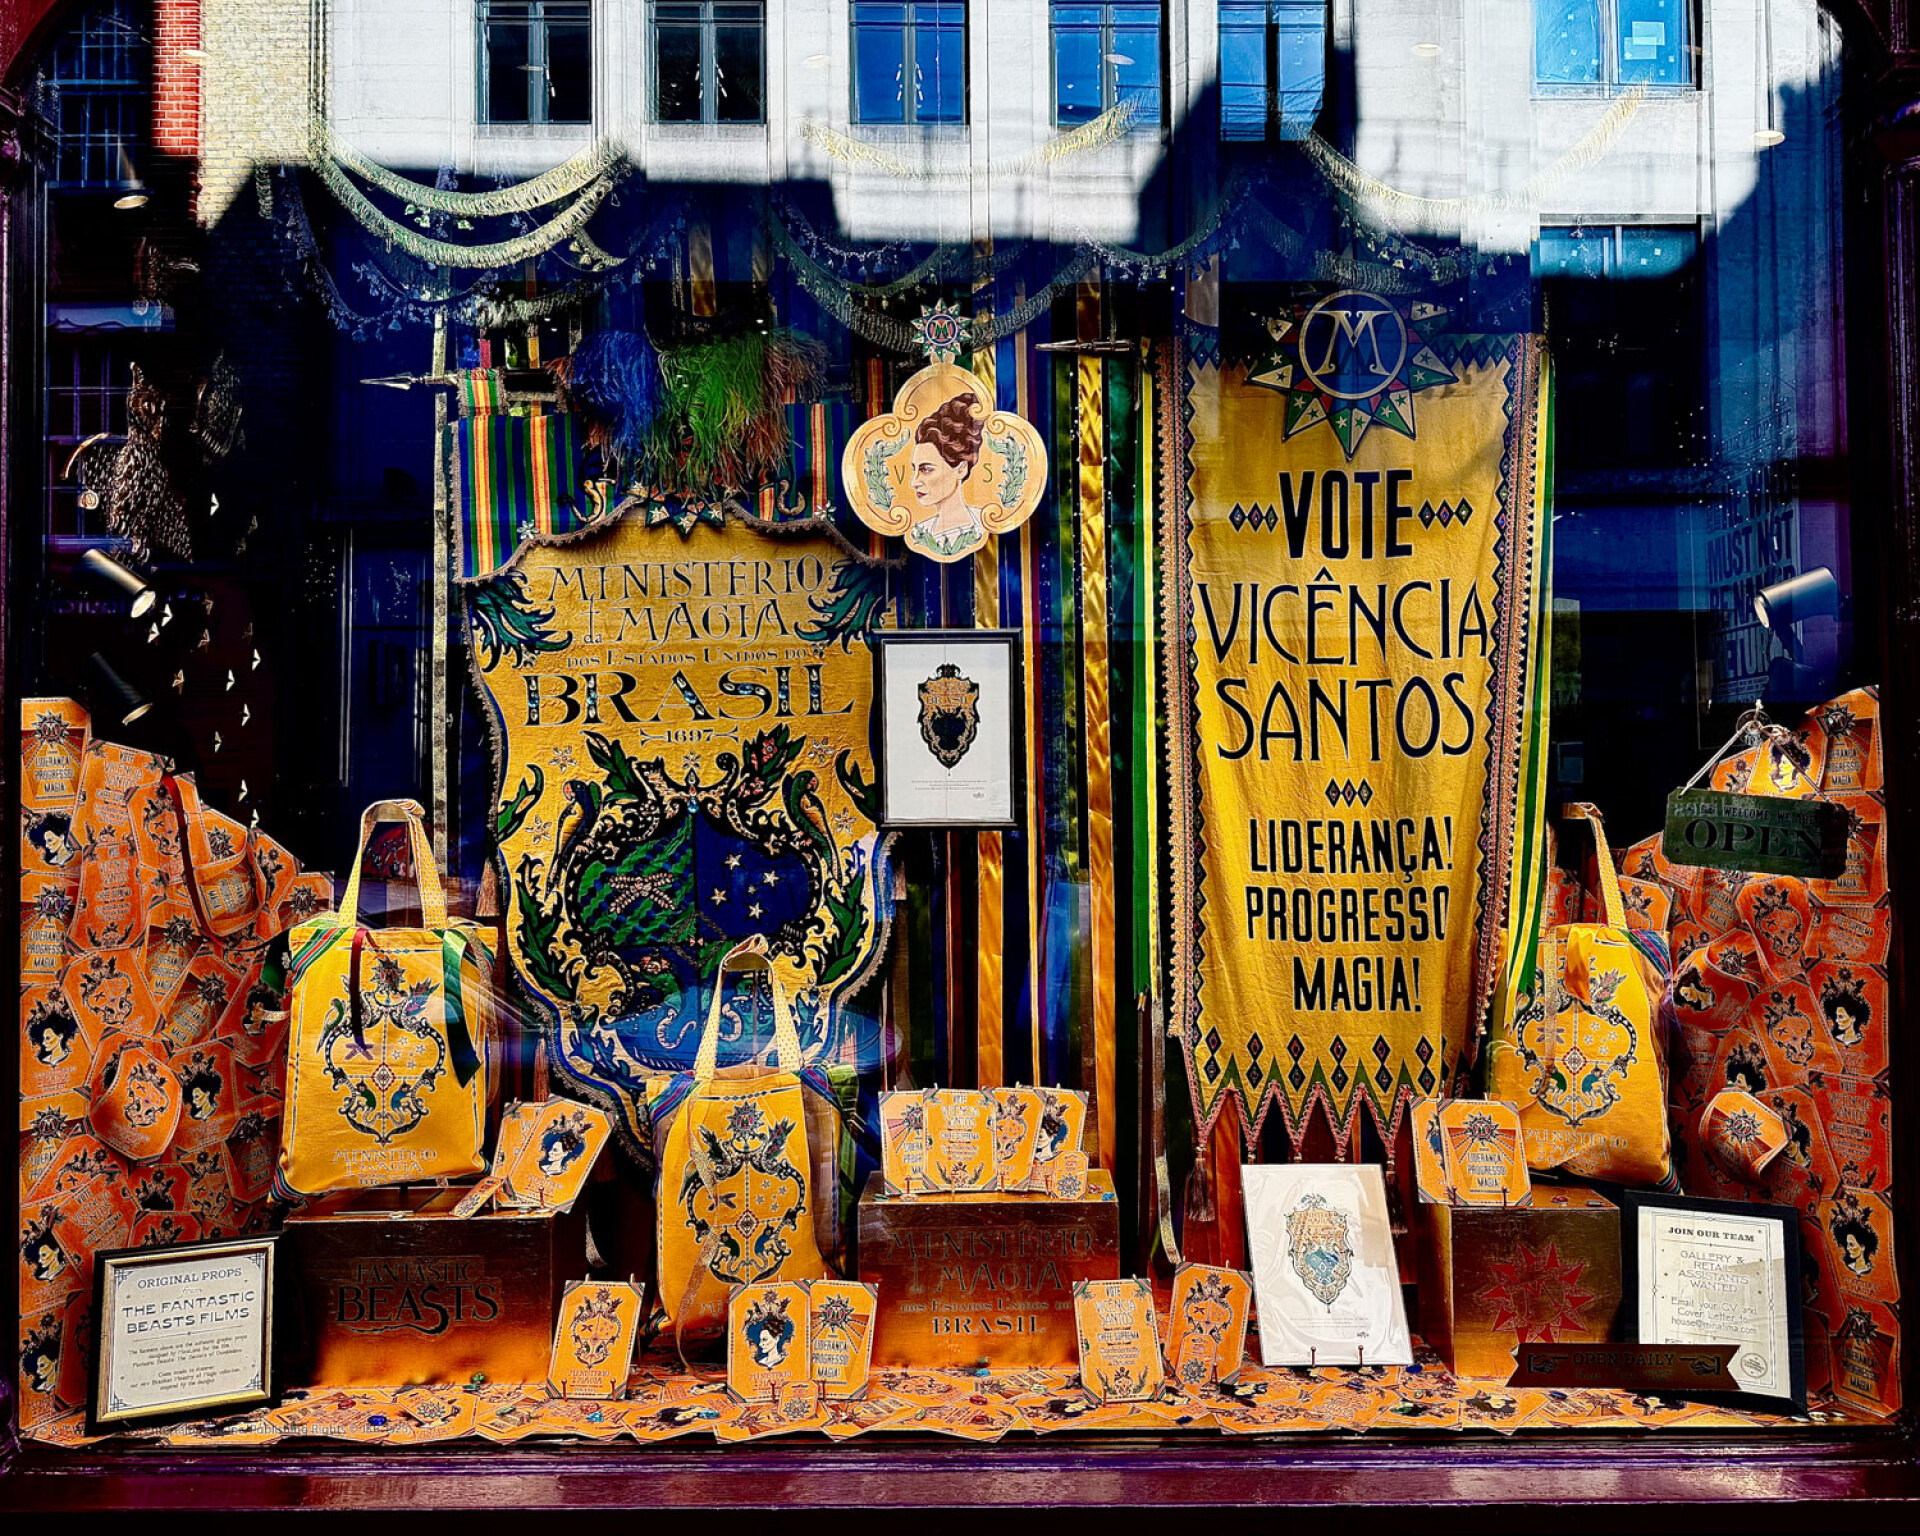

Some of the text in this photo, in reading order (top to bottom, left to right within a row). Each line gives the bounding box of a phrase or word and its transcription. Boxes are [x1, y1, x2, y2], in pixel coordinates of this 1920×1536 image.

[894, 464, 906, 485] V
[982, 462, 994, 484] S
[1278, 469, 1413, 561] VOTE
[1707, 527, 1752, 586] MUST
[539, 553, 823, 602] MINISTÉRIO
[611, 599, 794, 649] MAGIA
[1196, 566, 1489, 666] VICÊNCIA
[522, 663, 856, 727] BRASIL
[1215, 672, 1475, 762] SANTOS
[665, 728, 714, 744] 1697
[1250, 815, 1454, 884] LIDERANÇA!
[1684, 818, 1823, 860] OPEN
[1245, 885, 1450, 942] PROGRESSO
[1293, 955, 1423, 1013] MAGIA!
[1668, 1227, 1755, 1242] JOIN OUR TEAM
[1680, 1250, 1732, 1264] GALLERY
[1694, 1260, 1732, 1273] RETAIL
[137, 1267, 243, 1290] ORIGINAL PROPS
[355, 1261, 479, 1285] FANTASTIC
[936, 1261, 1066, 1298] MAGIA
[1678, 1269, 1750, 1285] ASSISTANTS
[1689, 1280, 1738, 1293] WANTED
[122, 1290, 256, 1318] THE FANTASTIC
[335, 1283, 500, 1335] BEASTS
[1671, 1296, 1695, 1308] Email
[1699, 1301, 1718, 1313] your
[1741, 1306, 1757, 1316] and
[1677, 1307, 1704, 1318] Cover
[1708, 1310, 1736, 1322] Letter
[127, 1307, 251, 1335] BEASTS FILMS
[932, 1315, 1046, 1335] BRASIL
[1099, 1312, 1135, 1327] SANTOS
[1571, 1351, 1676, 1366] OPEN DAILY
